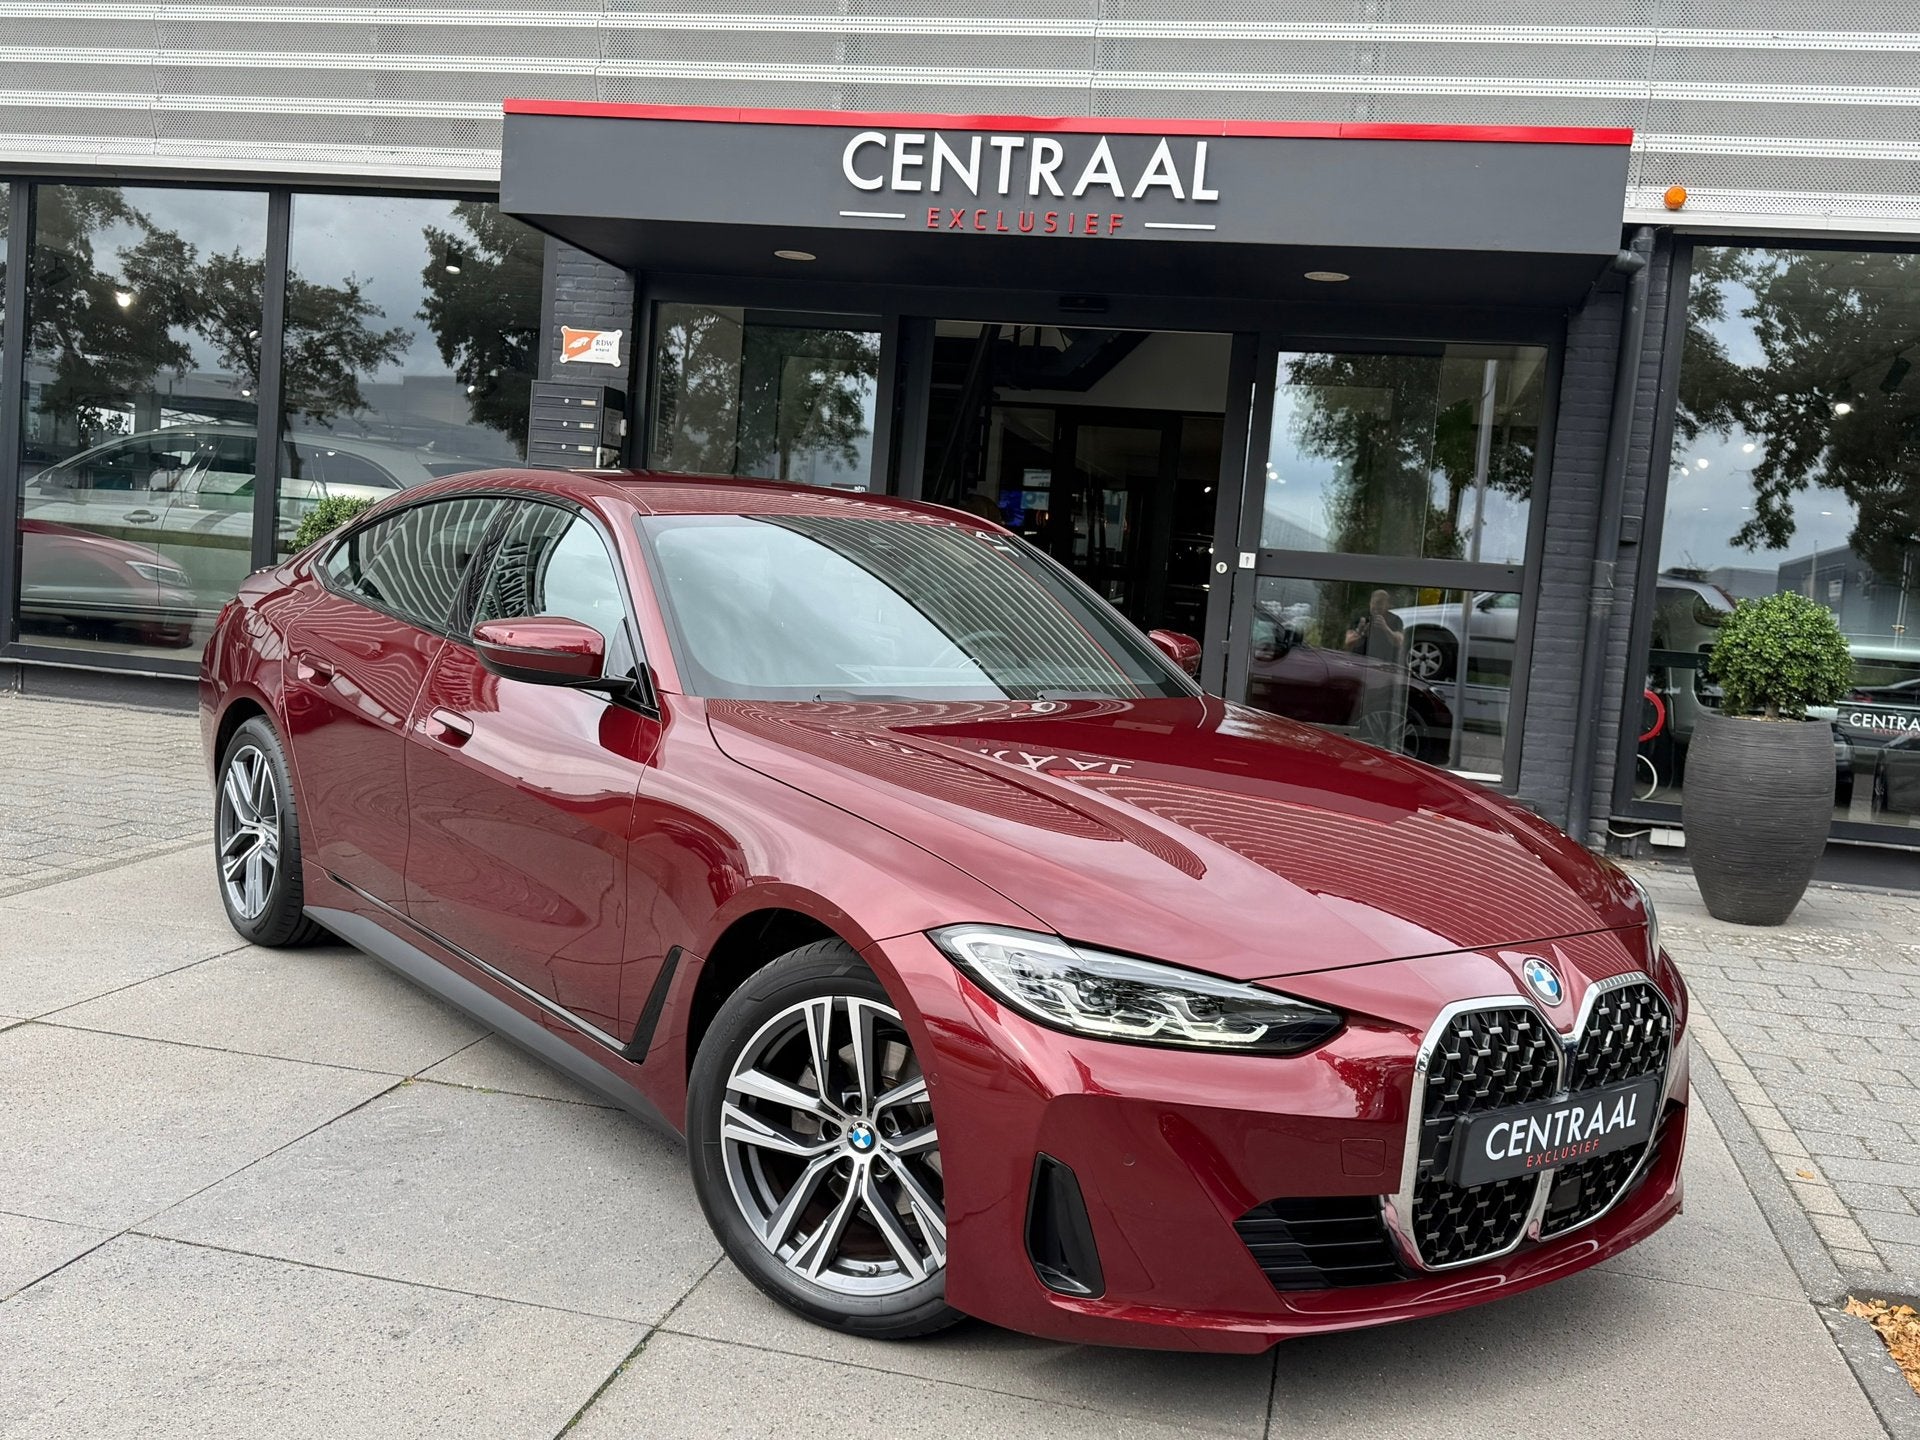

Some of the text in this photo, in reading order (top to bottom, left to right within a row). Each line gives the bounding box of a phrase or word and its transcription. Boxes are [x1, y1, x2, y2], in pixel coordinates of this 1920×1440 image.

[842, 131, 1219, 201] CENTRAAL
[927, 207, 1124, 234] EXCLUSIEF
[1850, 713, 1920, 731] CENTRA
[1485, 1093, 1637, 1161] CENTRAAL
[1526, 1138, 1600, 1168] EXCLUSIEF
